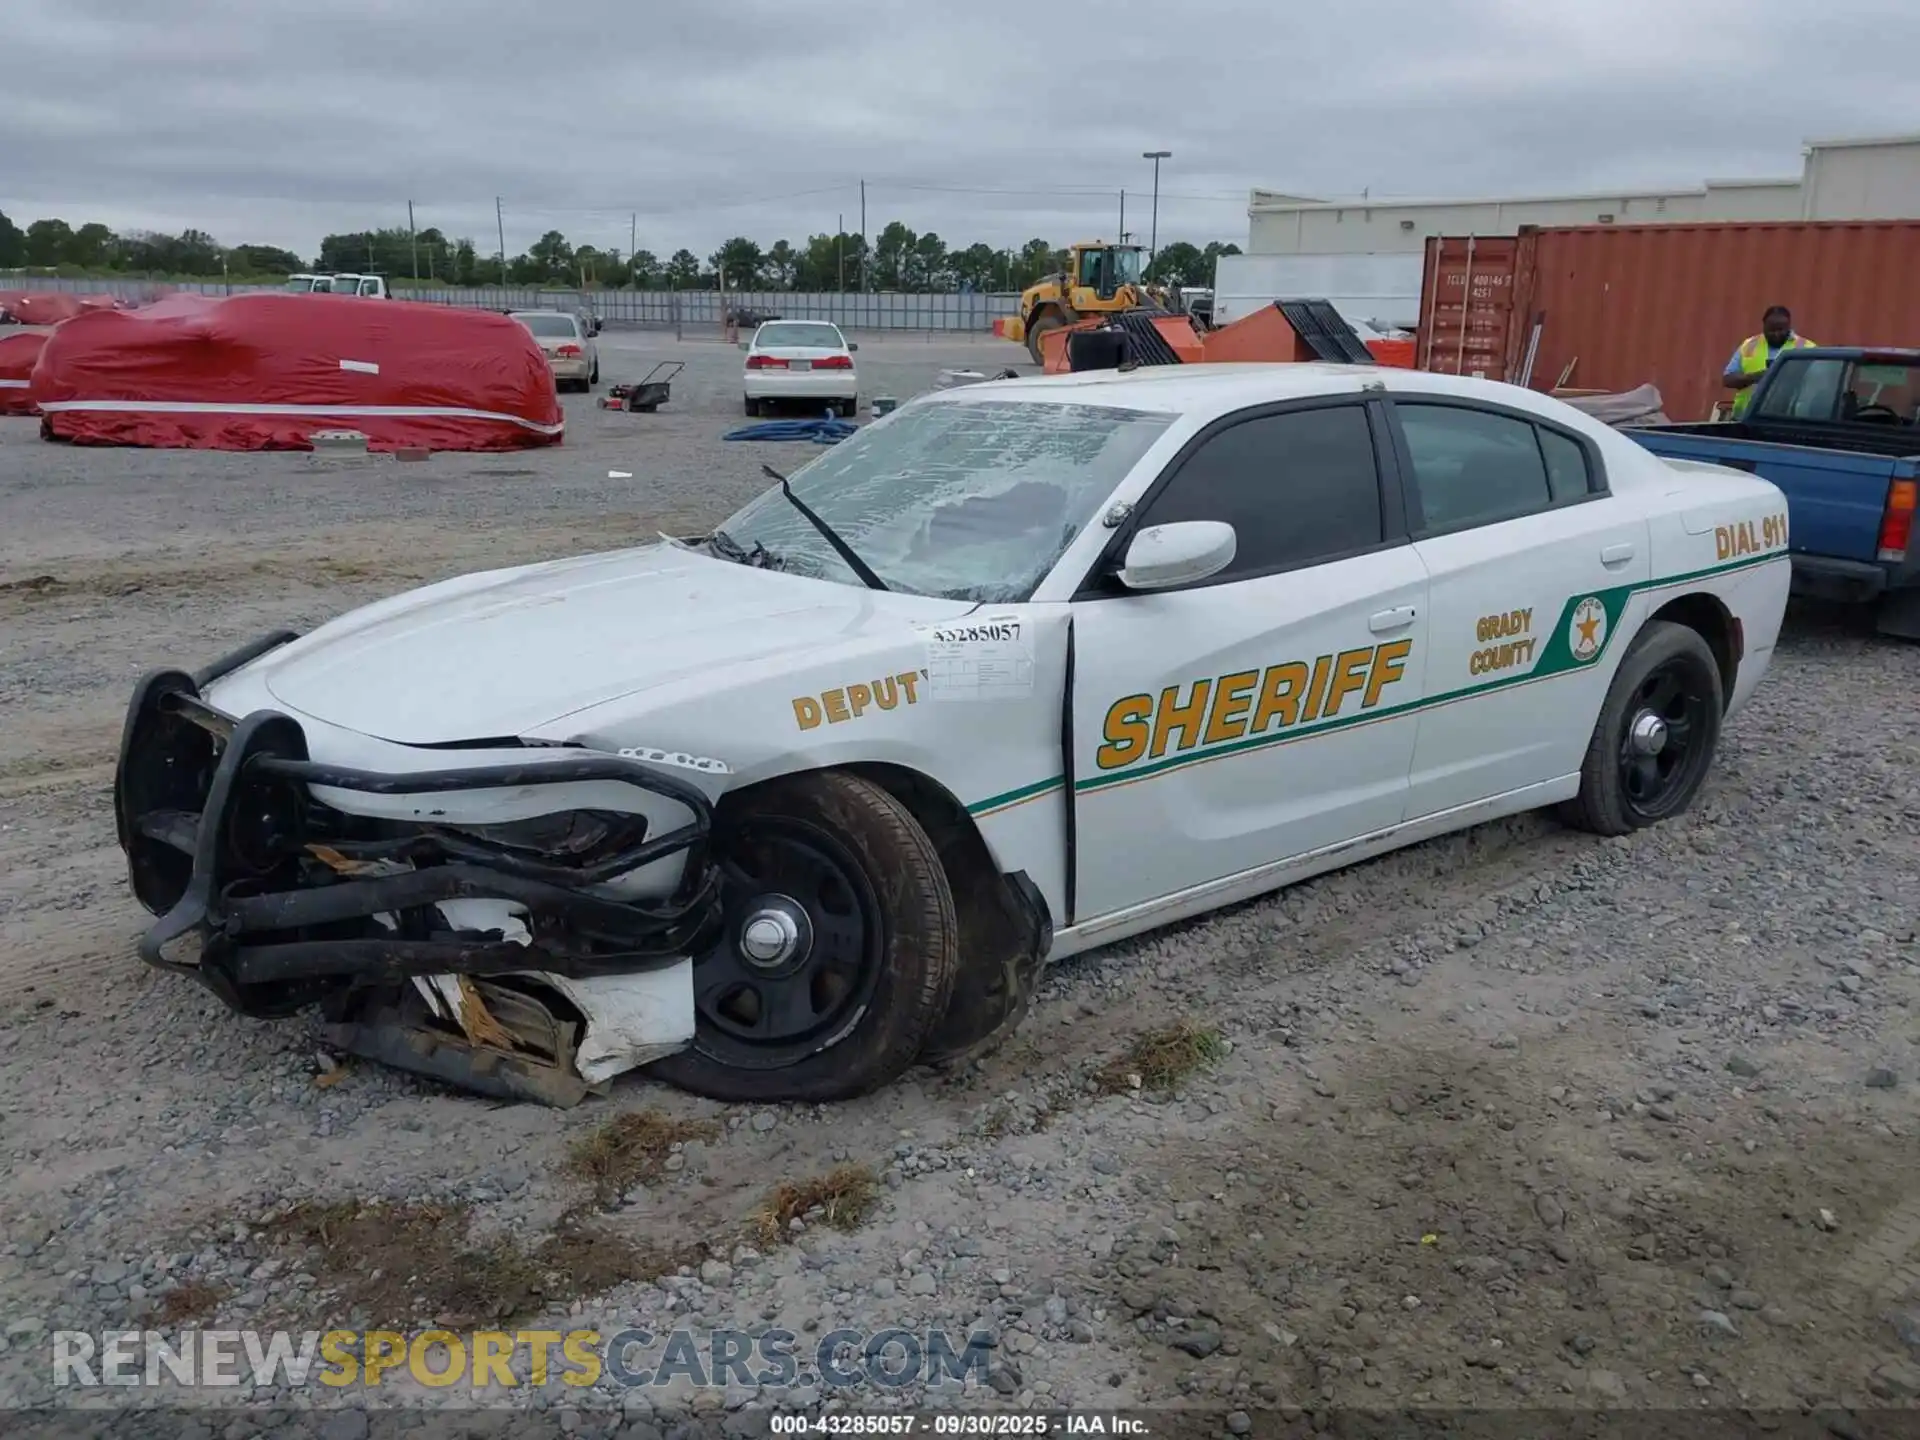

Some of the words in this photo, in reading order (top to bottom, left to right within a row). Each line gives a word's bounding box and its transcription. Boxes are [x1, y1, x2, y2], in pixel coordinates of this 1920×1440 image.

[1715, 520, 1761, 561] DIAL
[1762, 513, 1787, 549] 911
[933, 624, 1020, 641] 43285057
[1476, 607, 1533, 642] GRADY
[1470, 638, 1537, 675] COUNTY
[1096, 638, 1413, 769] SHERIFF
